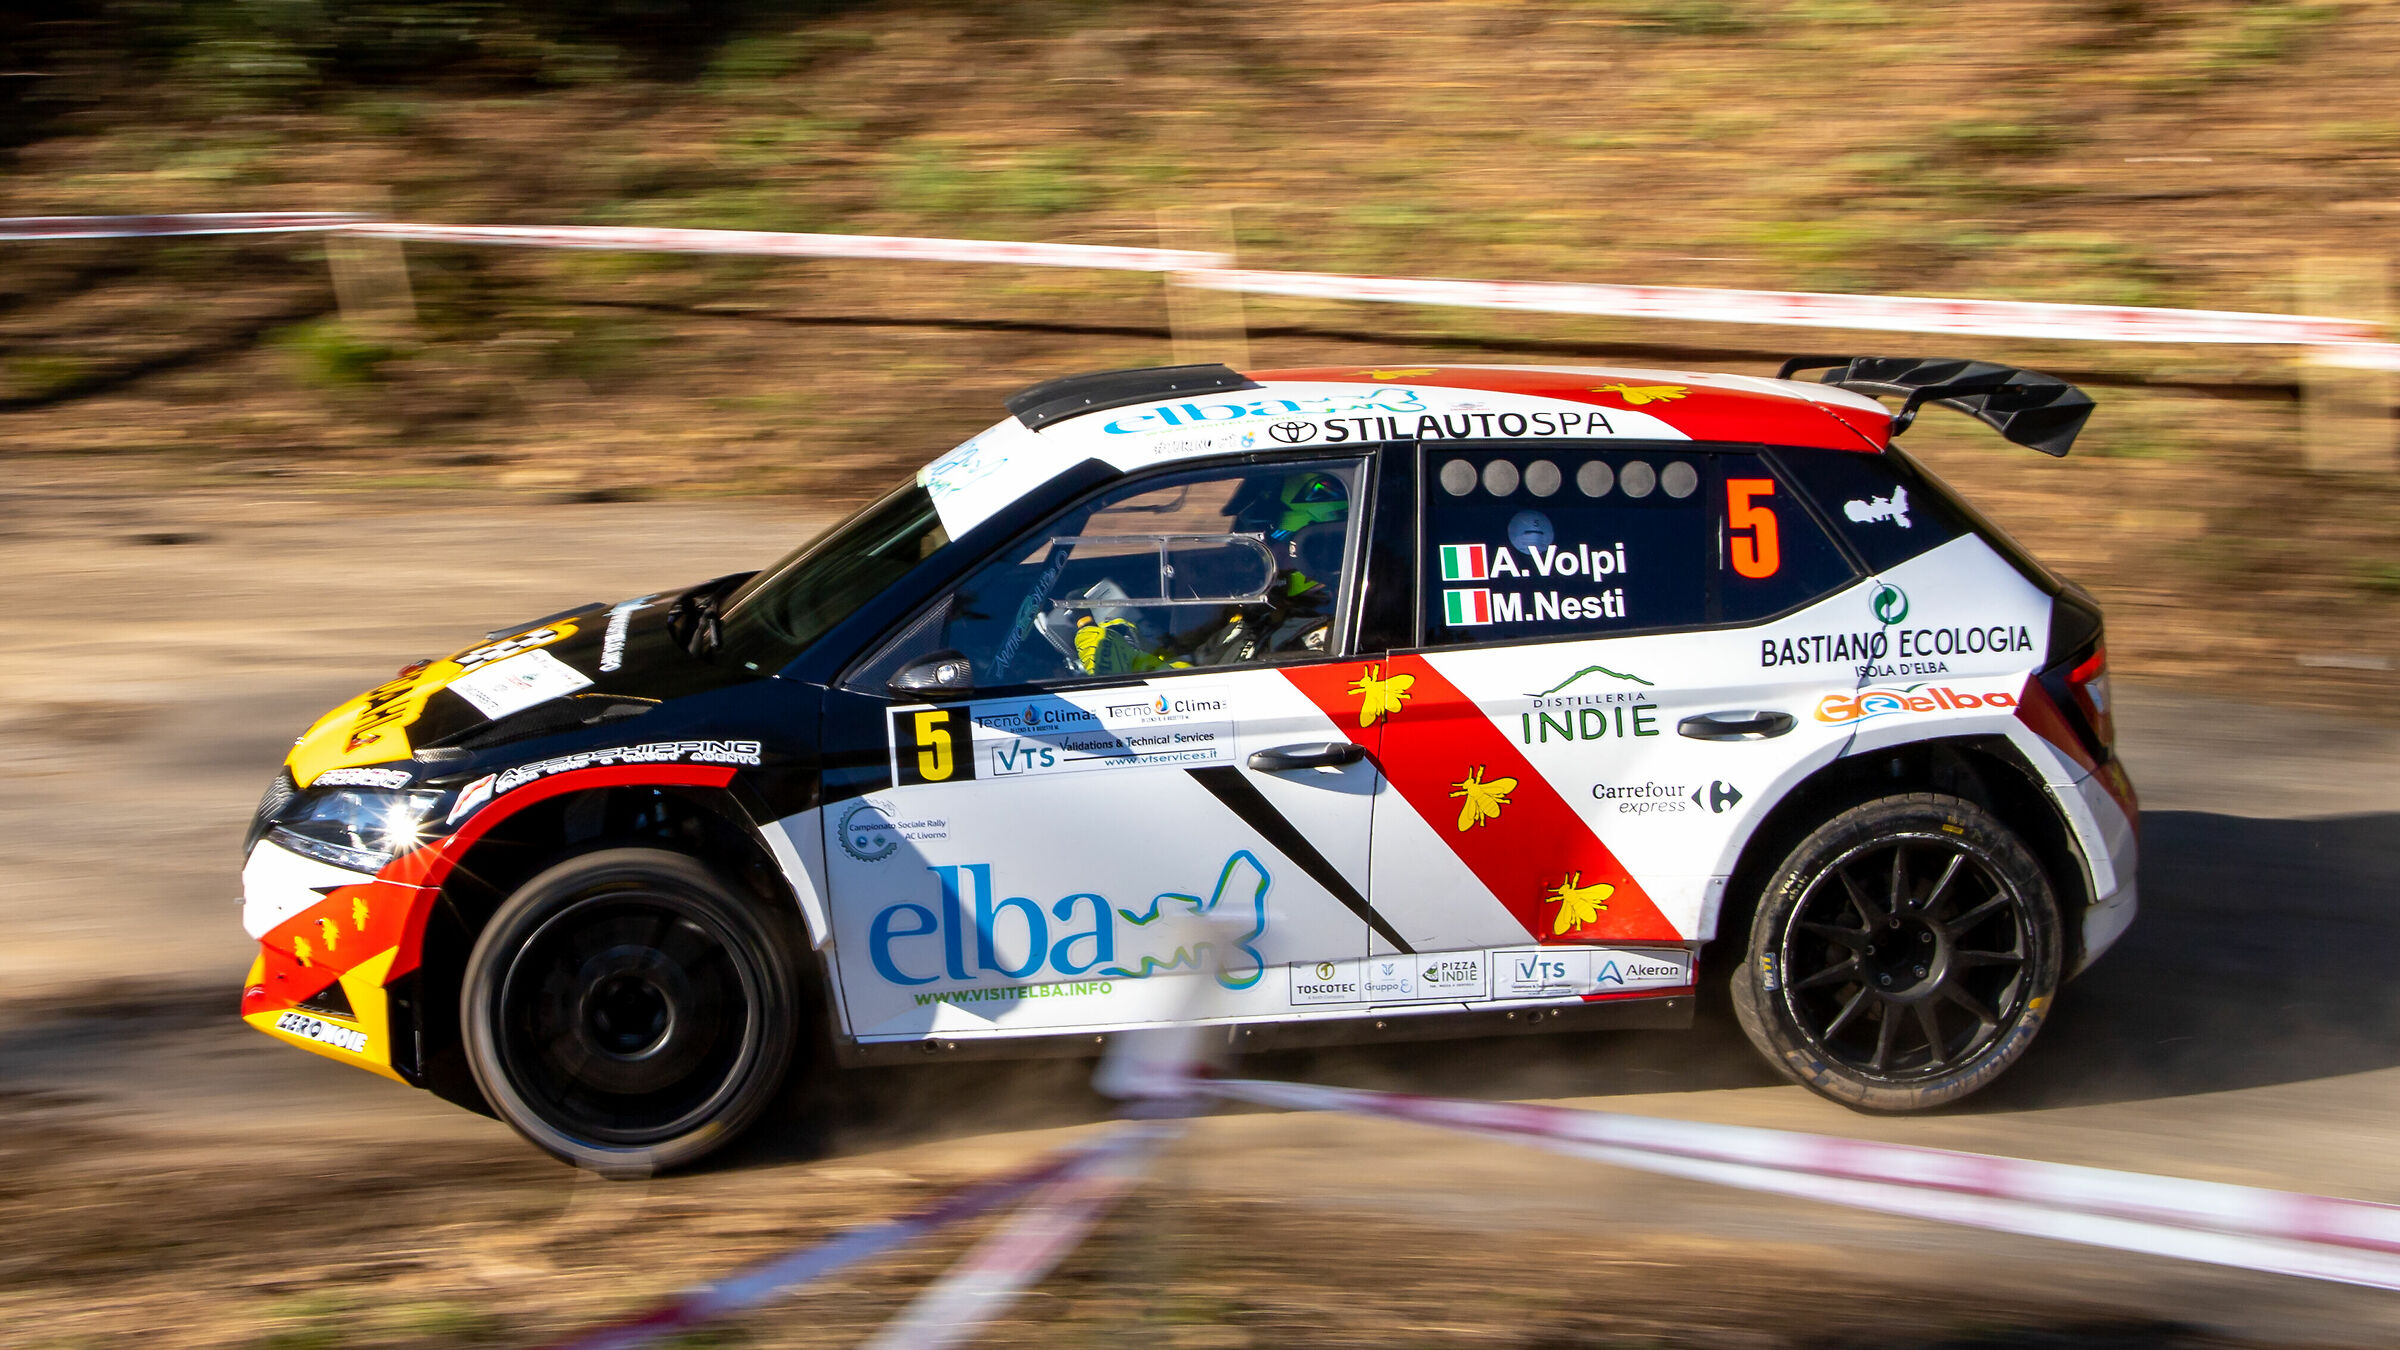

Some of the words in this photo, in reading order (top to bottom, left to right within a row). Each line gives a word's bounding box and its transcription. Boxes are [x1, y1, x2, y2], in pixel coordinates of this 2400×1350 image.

[1726, 478, 1780, 579] 5
[1490, 542, 1627, 583] A.Volpi
[1493, 588, 1626, 623] M.Nesti
[1761, 631, 1888, 668] BASTIANO
[1899, 626, 2033, 658] ECOLOGIA
[1855, 664, 1896, 679] ISOLA
[1900, 660, 1949, 676] D'ELBA
[1105, 703, 1151, 719] Tecno
[1174, 699, 1221, 713] Clima
[1533, 692, 1646, 709] DISTILLERIA
[974, 713, 1021, 729] Tecno
[1044, 708, 1091, 723] Clima
[1522, 703, 1660, 745] INDIE
[913, 709, 954, 782] 5
[1059, 736, 1113, 752] Validations
[1115, 740, 1123, 748] &
[1125, 734, 1170, 747] Technical
[1174, 731, 1215, 744] Services
[497, 741, 761, 782] ASSOSHIPPING
[997, 738, 1055, 771] VTS
[1104, 749, 1218, 768] www.vtservices.it
[1592, 782, 1686, 801] Carrefour
[1618, 799, 1686, 816] express
[849, 822, 896, 832] Campionato
[897, 820, 926, 829] Sociale
[927, 819, 947, 829] Rally
[904, 832, 916, 840] AC
[917, 832, 947, 840] Livorno
[869, 863, 1114, 986] elba
[1441, 961, 1477, 970] PIZZA
[1520, 954, 1566, 979] VTS
[1625, 964, 1679, 976] Akeron
[1441, 970, 1478, 982] INDIE
[914, 982, 1112, 1006] WWW.VISITELBA.INFO
[1296, 982, 1357, 995] TOSCOTEC
[1364, 982, 1399, 992] Gruppo
